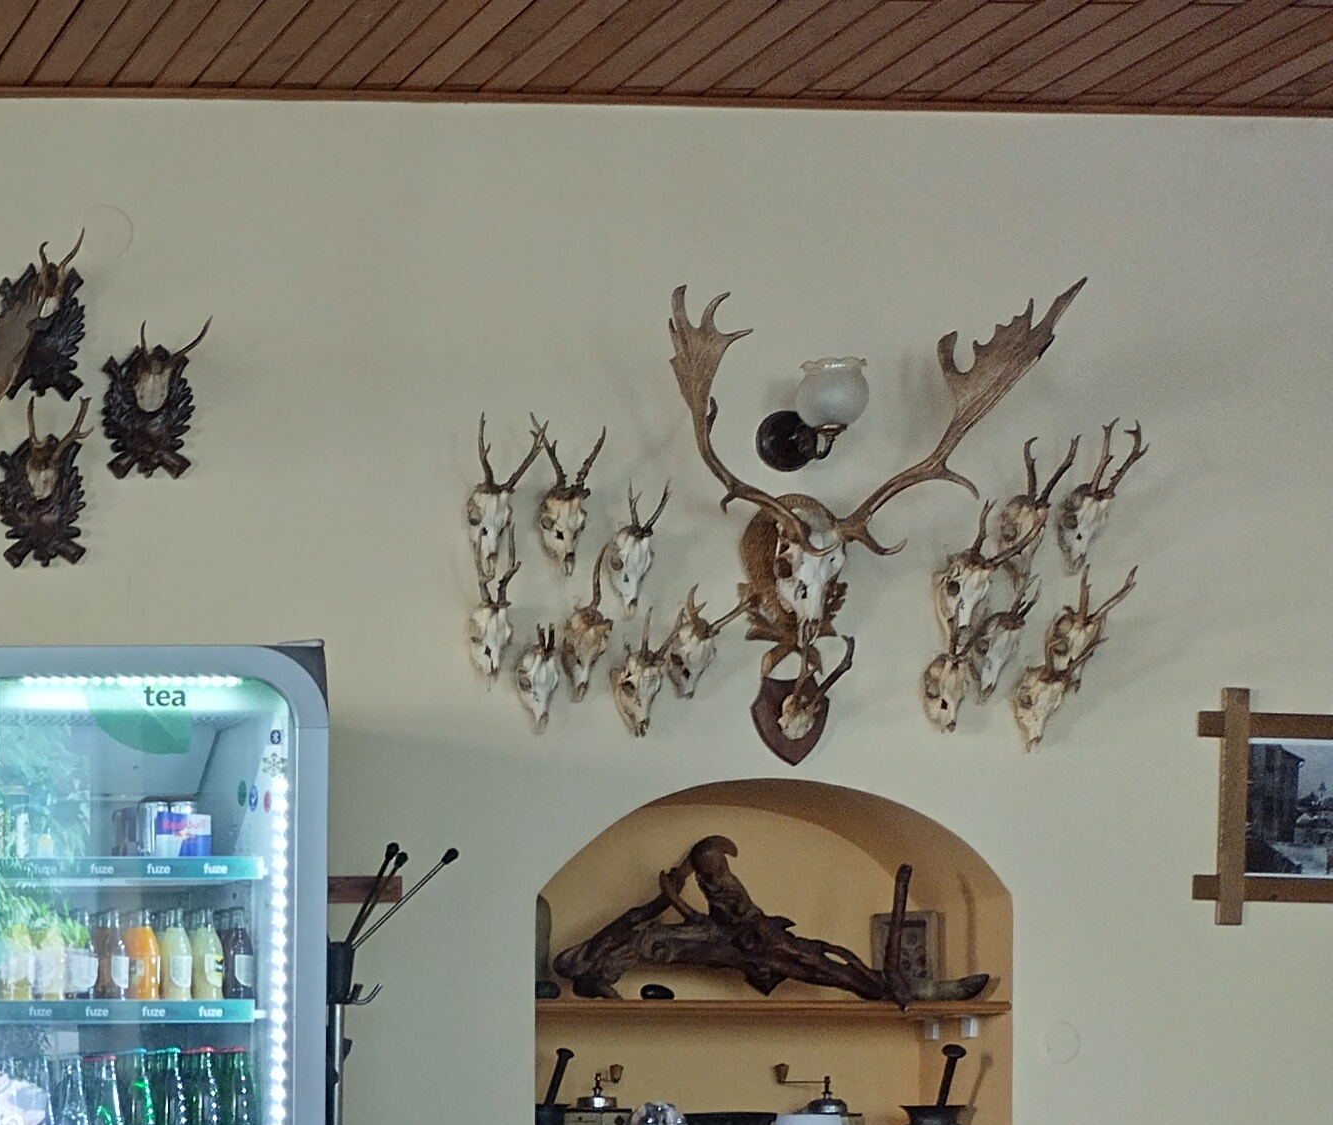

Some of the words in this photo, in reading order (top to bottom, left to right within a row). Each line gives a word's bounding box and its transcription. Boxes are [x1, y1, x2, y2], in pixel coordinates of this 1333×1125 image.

[143, 685, 187, 707] tea
[90, 864, 114, 875] fuze
[146, 863, 171, 875] fuze
[203, 863, 228, 875] fuze
[28, 1006, 52, 1017] fuze
[85, 1006, 109, 1017] fuze
[141, 1006, 166, 1018] fuze
[198, 1006, 223, 1017] fuze
